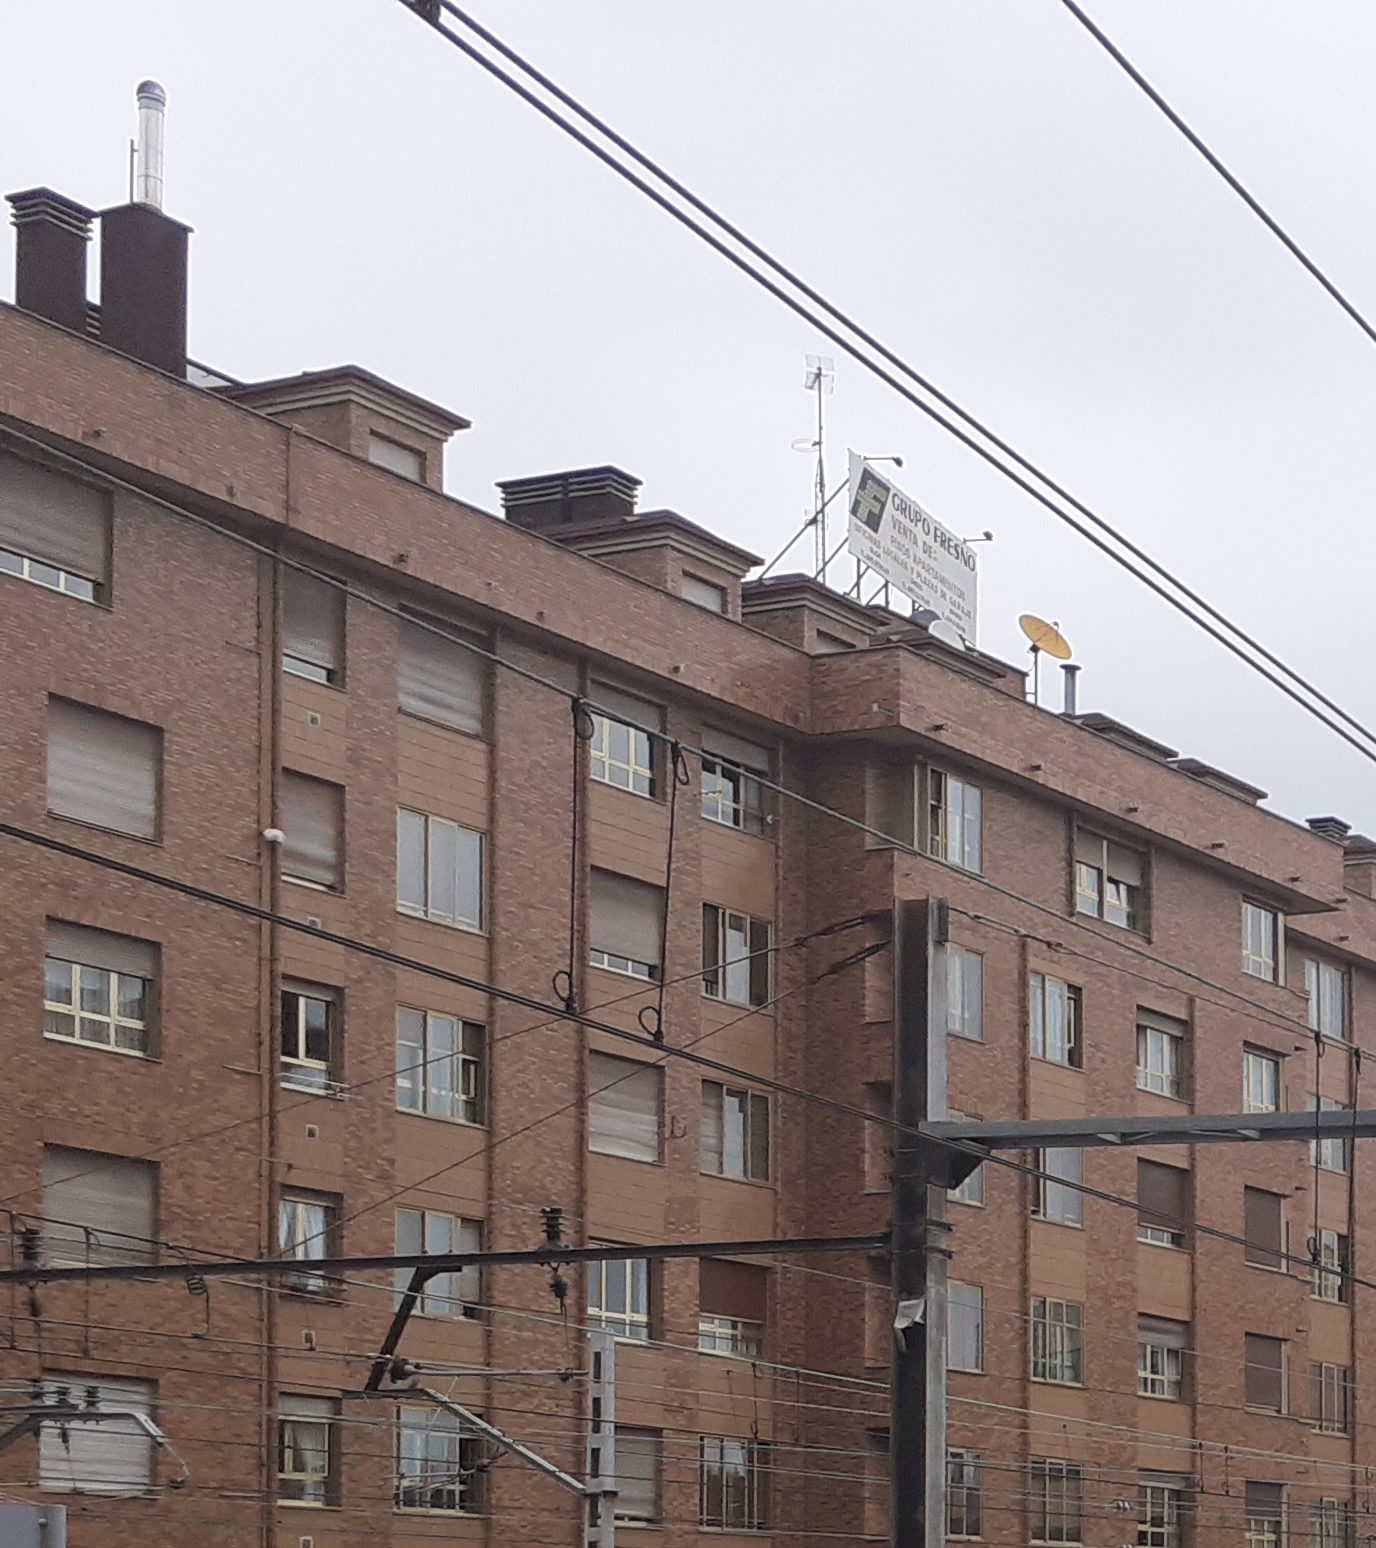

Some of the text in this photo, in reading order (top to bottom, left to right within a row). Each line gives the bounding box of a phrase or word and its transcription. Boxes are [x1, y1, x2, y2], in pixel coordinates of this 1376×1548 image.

[891, 514, 919, 548] VENTA
[892, 493, 931, 536] GRUPO
[933, 526, 976, 573] FRESNO
[883, 545, 909, 571] LOCALES
[916, 570, 938, 595] PLAZAS
[950, 594, 972, 620] GARAJE
[891, 535, 911, 560] PISOS
[912, 552, 966, 602] APARTAMENTOS
